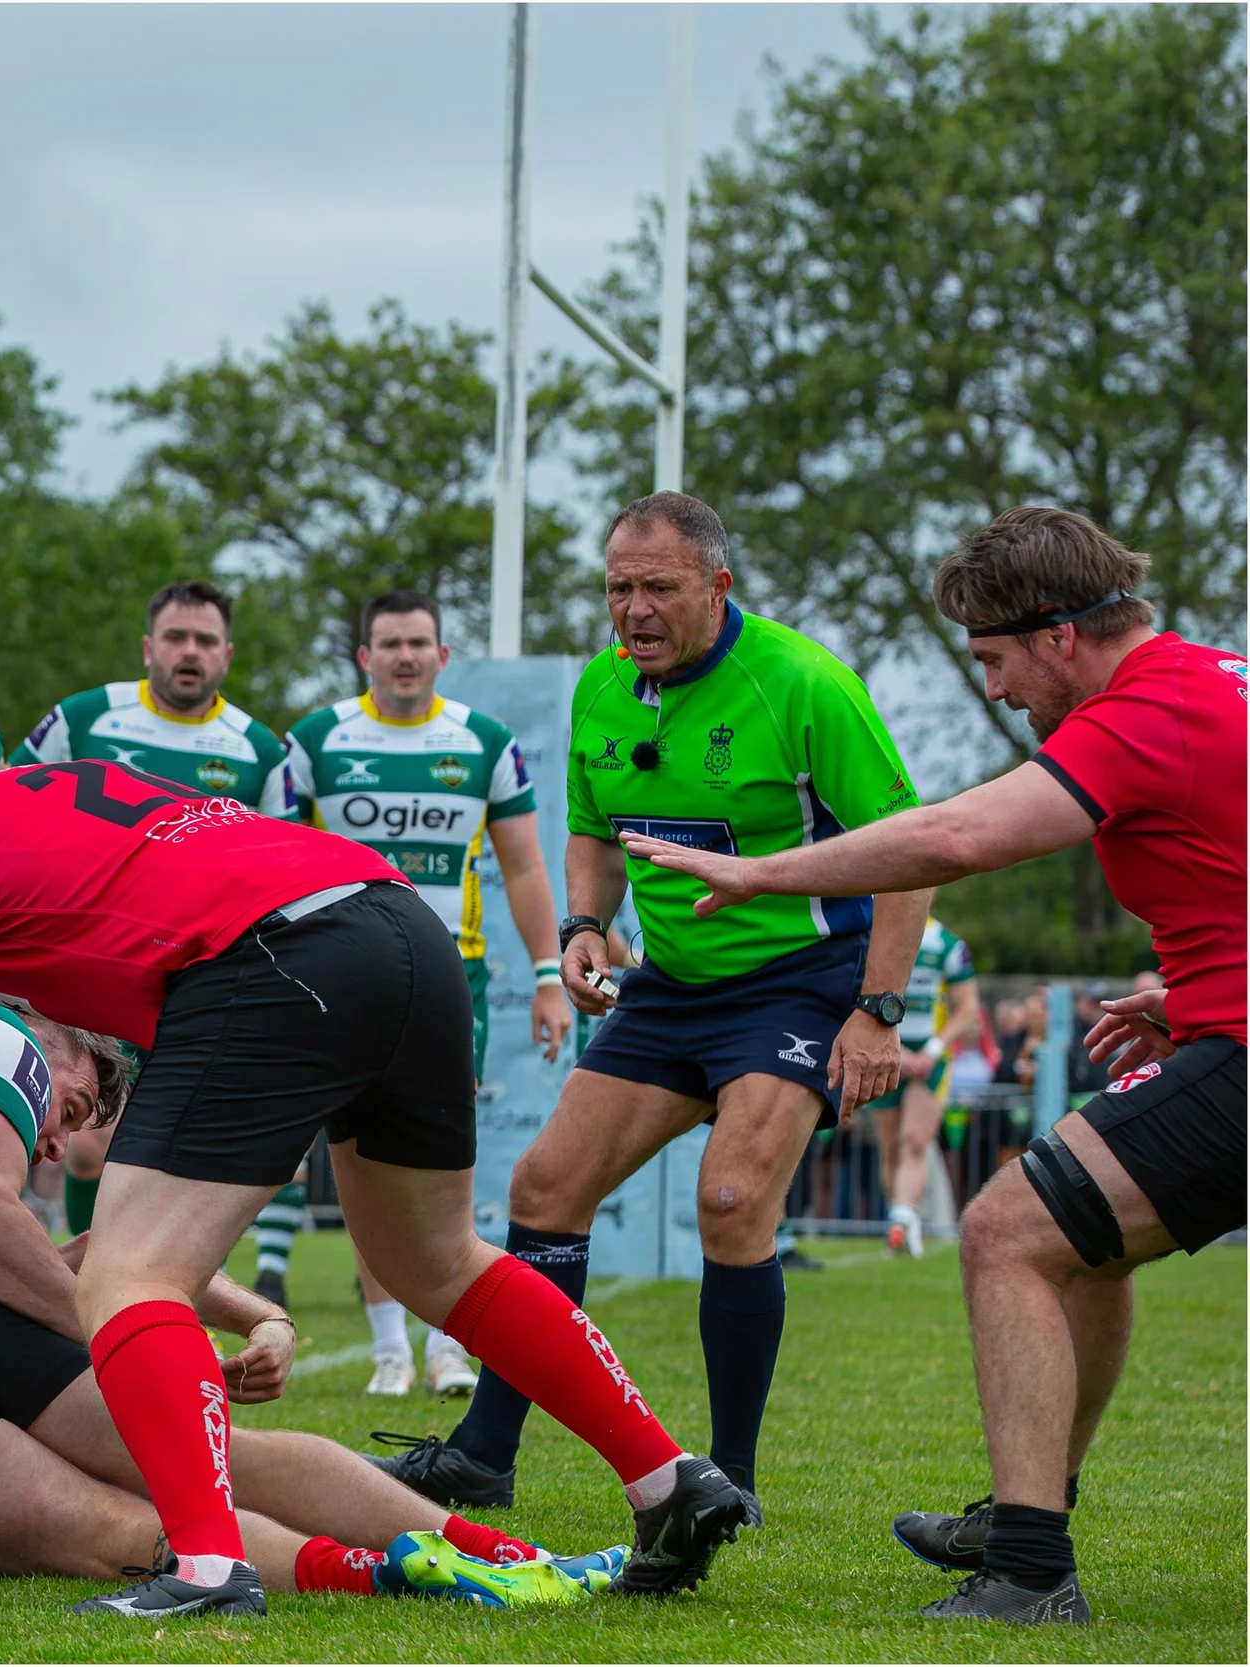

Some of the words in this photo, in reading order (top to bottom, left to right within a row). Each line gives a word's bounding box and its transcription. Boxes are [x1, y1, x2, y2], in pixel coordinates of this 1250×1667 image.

[591, 760, 625, 771] GILBERT
[343, 794, 464, 839] Ogier
[778, 1051, 818, 1068] GILBERT
[570, 1309, 650, 1417] SAMURAI
[200, 1380, 233, 1512] SAMURAI
